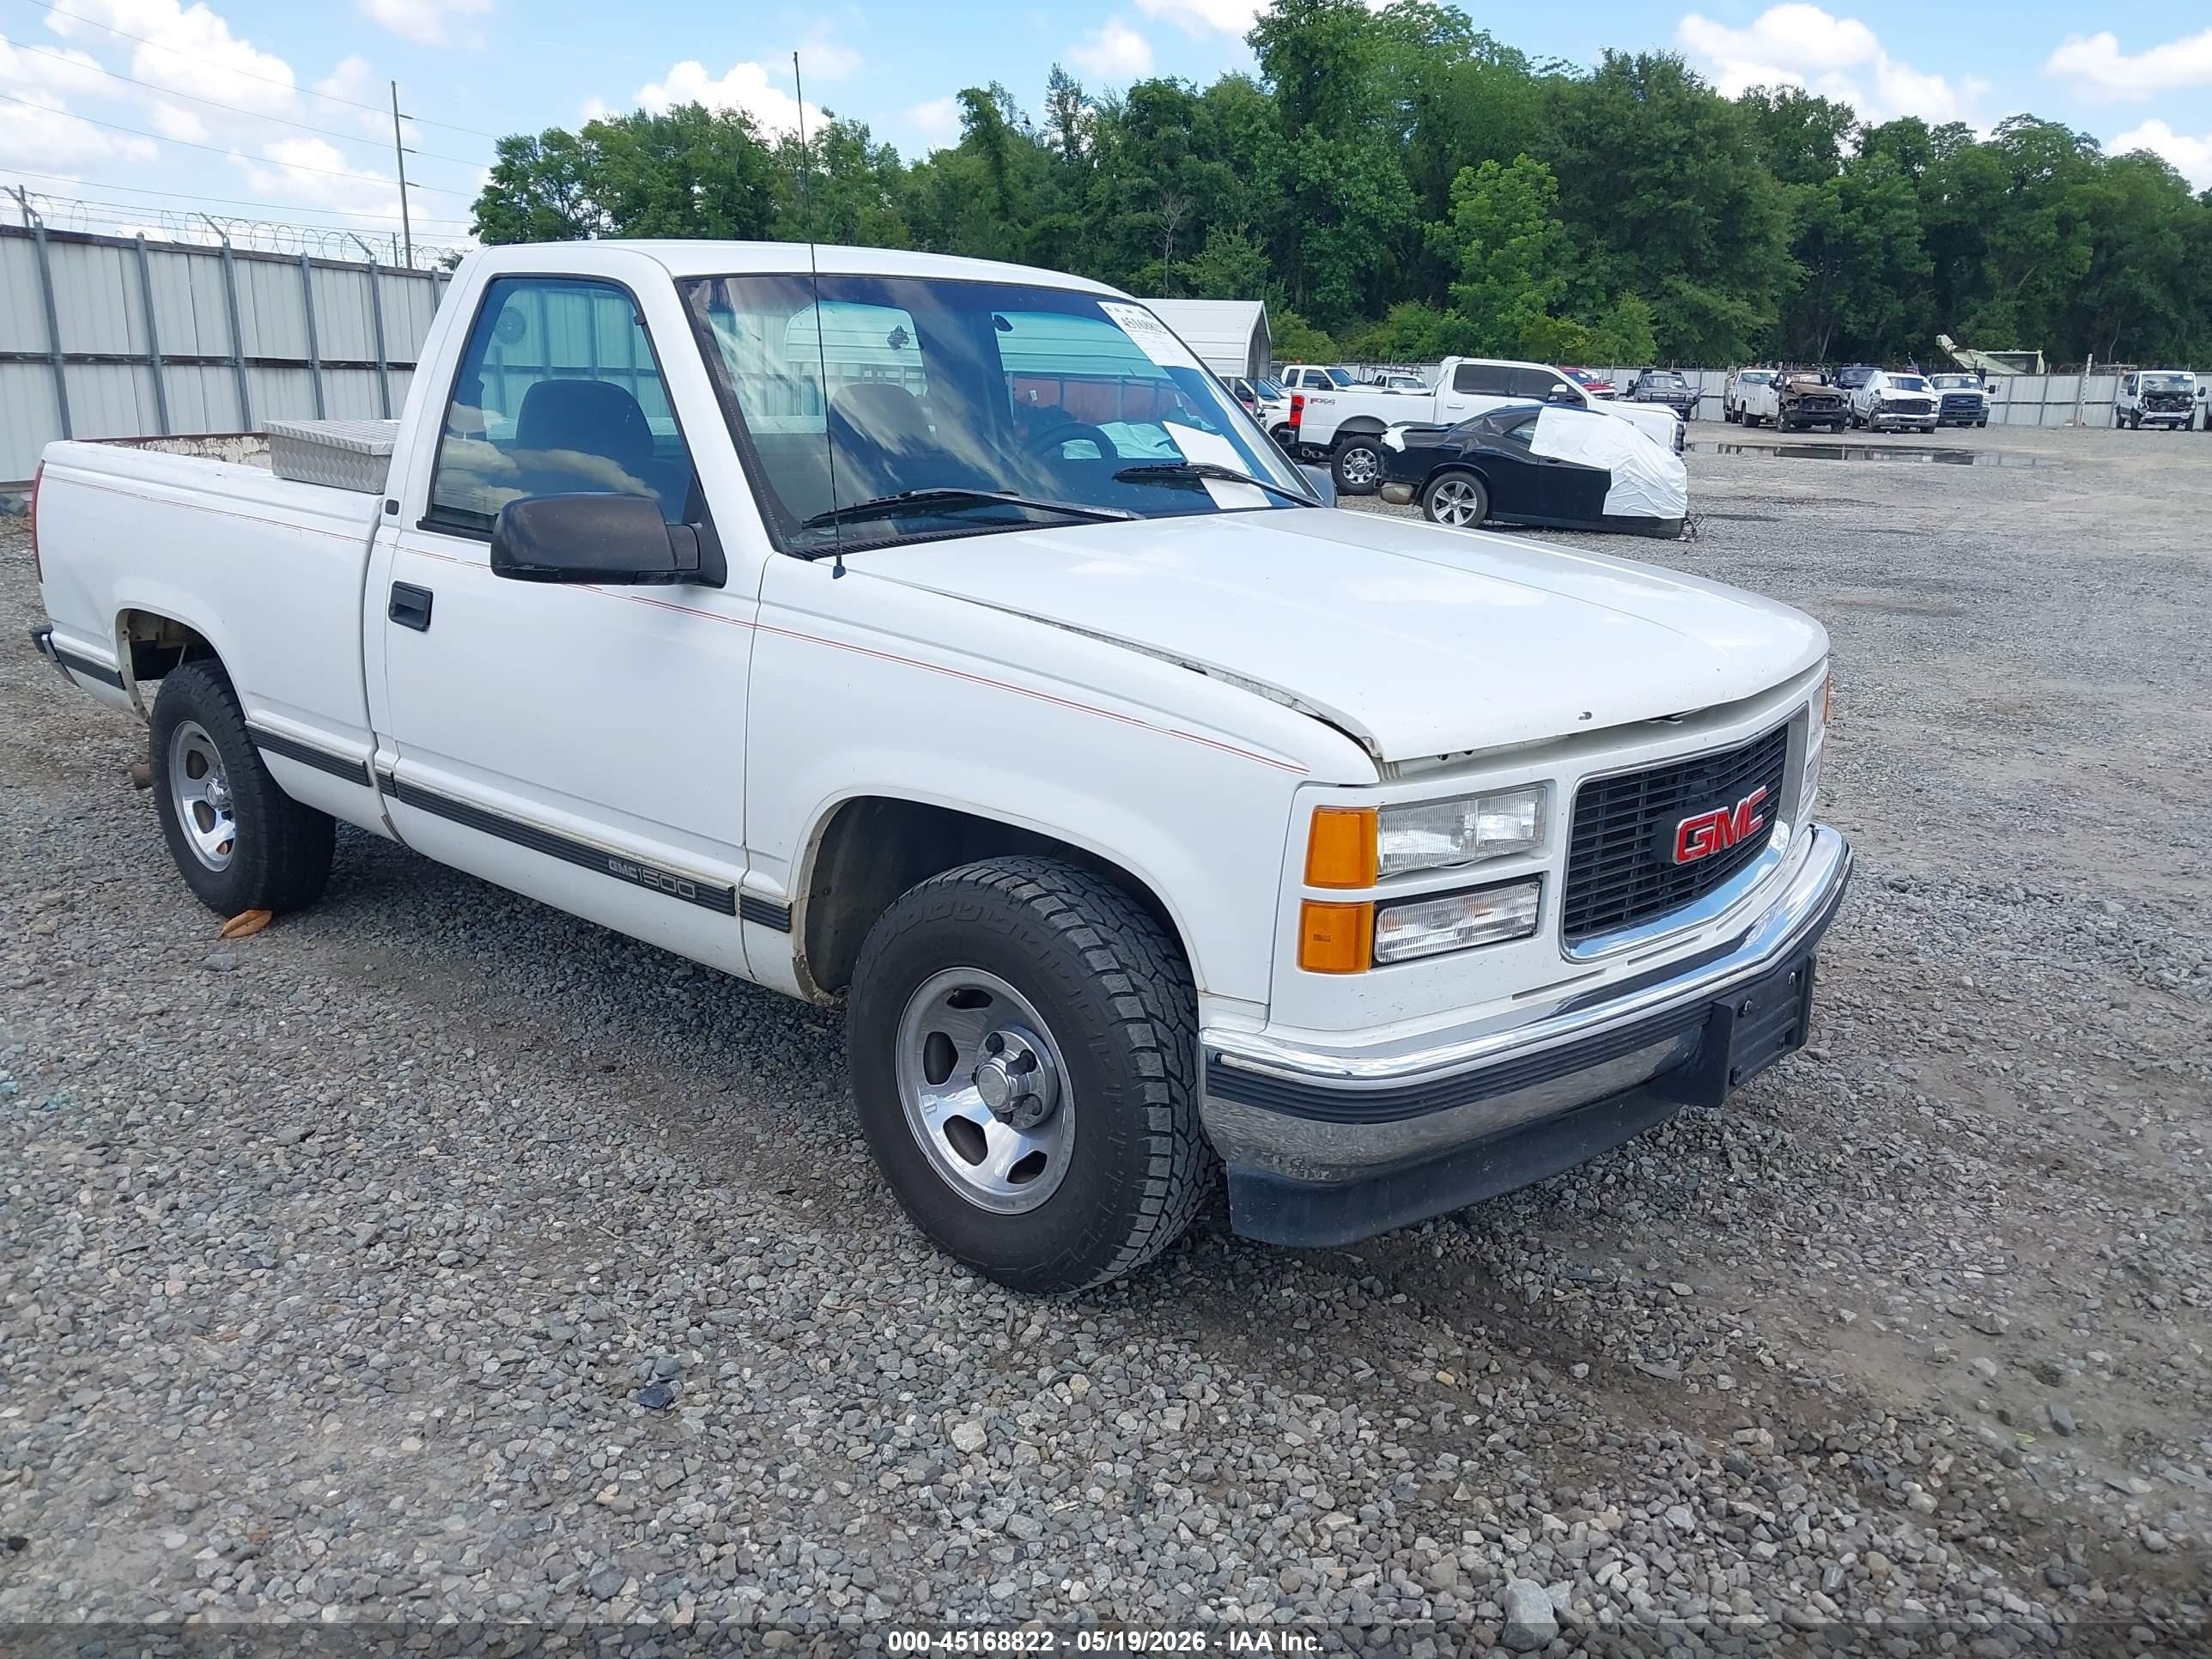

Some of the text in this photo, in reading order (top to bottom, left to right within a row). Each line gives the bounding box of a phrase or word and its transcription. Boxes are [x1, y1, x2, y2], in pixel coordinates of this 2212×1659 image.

[1672, 785, 1768, 865] GMC
[608, 859, 696, 899] GMC 1500
